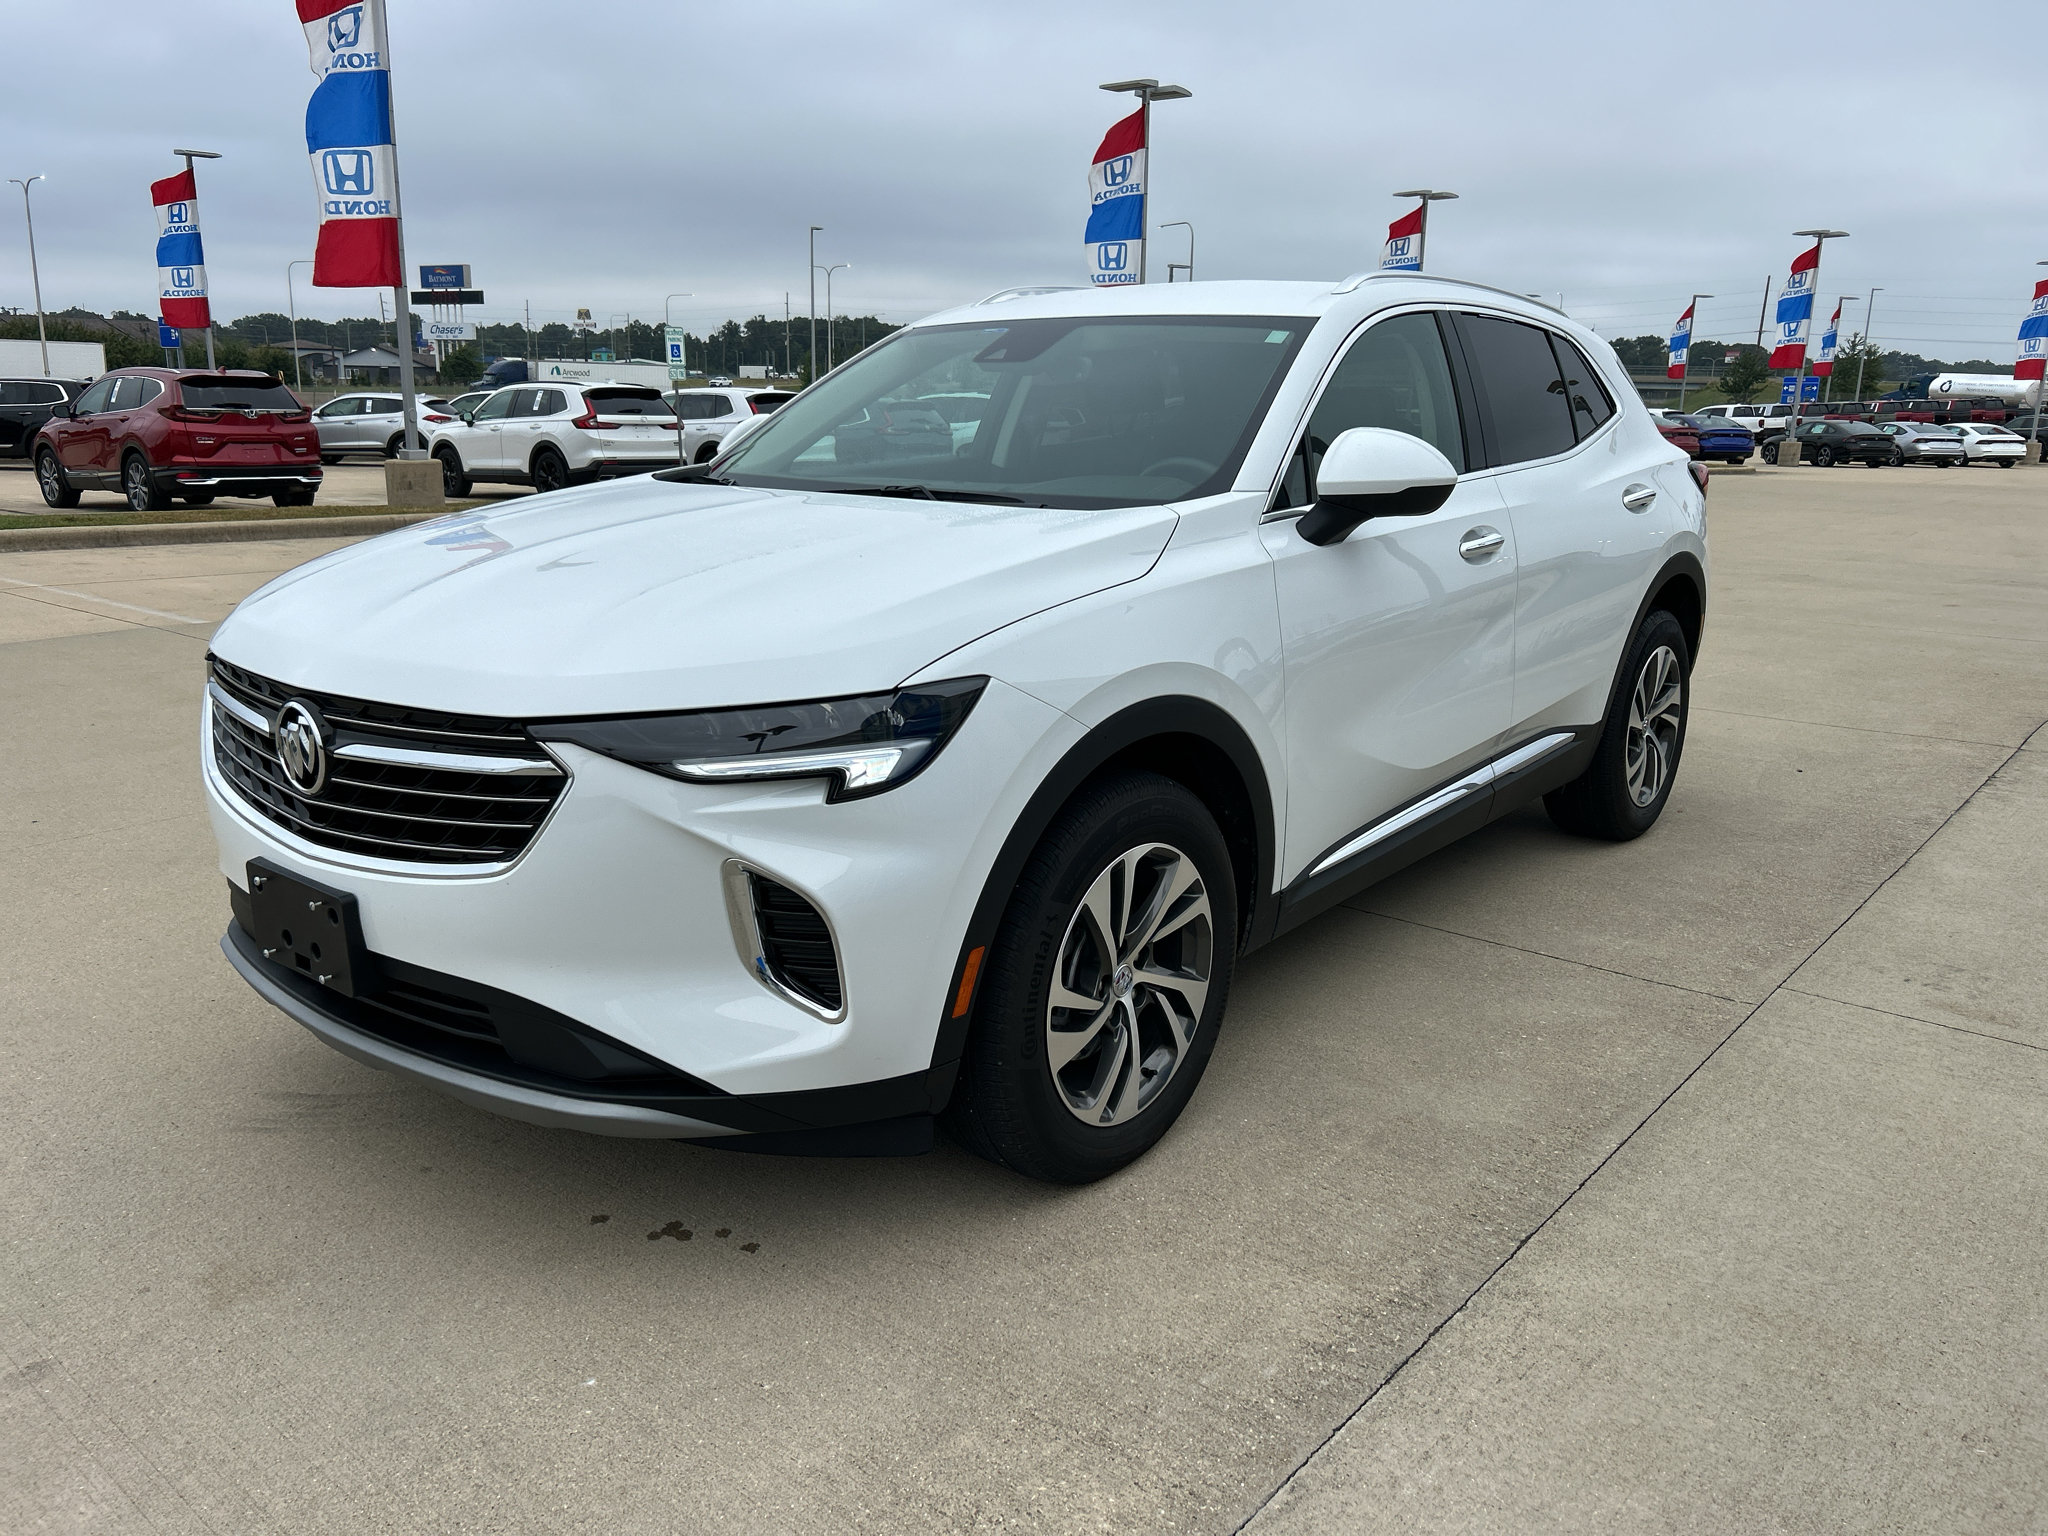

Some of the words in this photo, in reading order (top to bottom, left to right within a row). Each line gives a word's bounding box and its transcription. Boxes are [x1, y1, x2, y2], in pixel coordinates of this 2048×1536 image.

[428, 275, 456, 283] BAYMONT
[430, 324, 464, 335] Chaser's
[562, 368, 590, 377] Arcwood
